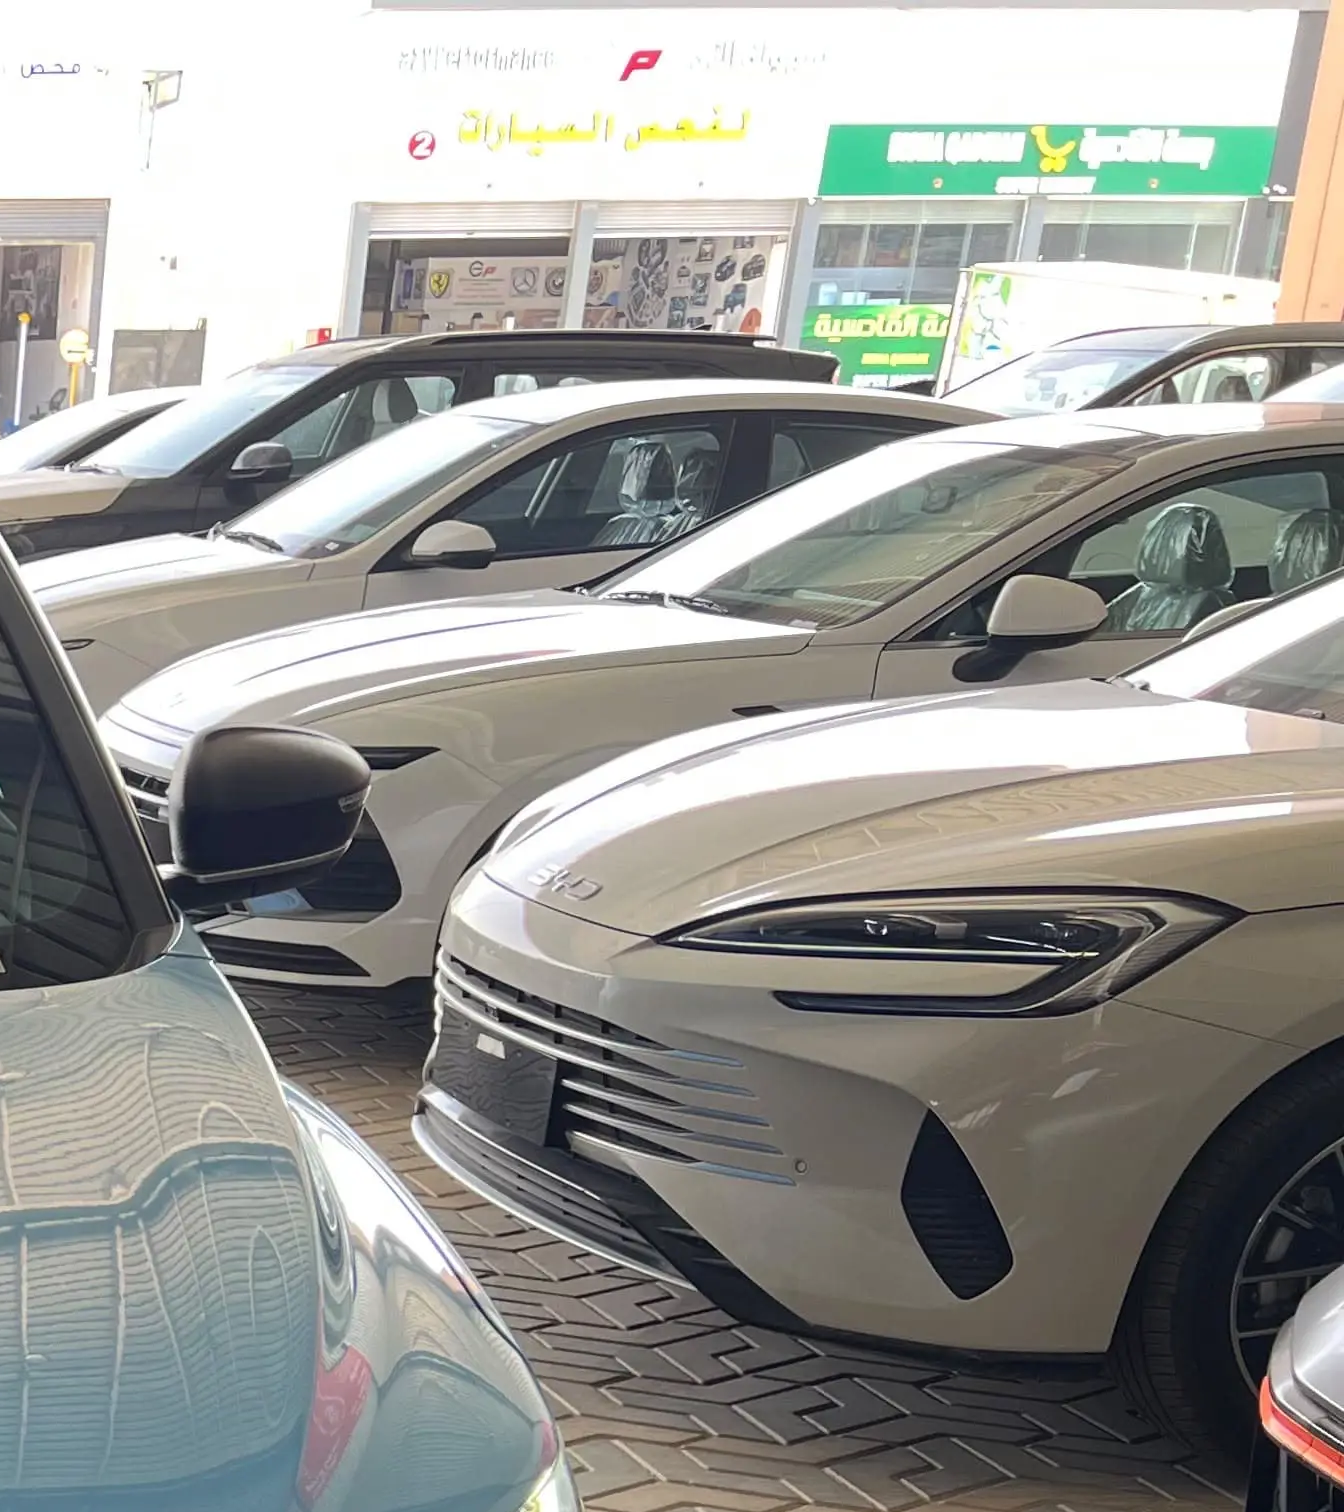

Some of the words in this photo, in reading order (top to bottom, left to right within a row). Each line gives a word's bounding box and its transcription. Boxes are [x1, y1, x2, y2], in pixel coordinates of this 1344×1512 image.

[413, 133, 435, 158] 2
[457, 107, 617, 157] السيارات
[623, 104, 753, 151] لفحص
[528, 863, 604, 902] BYD
